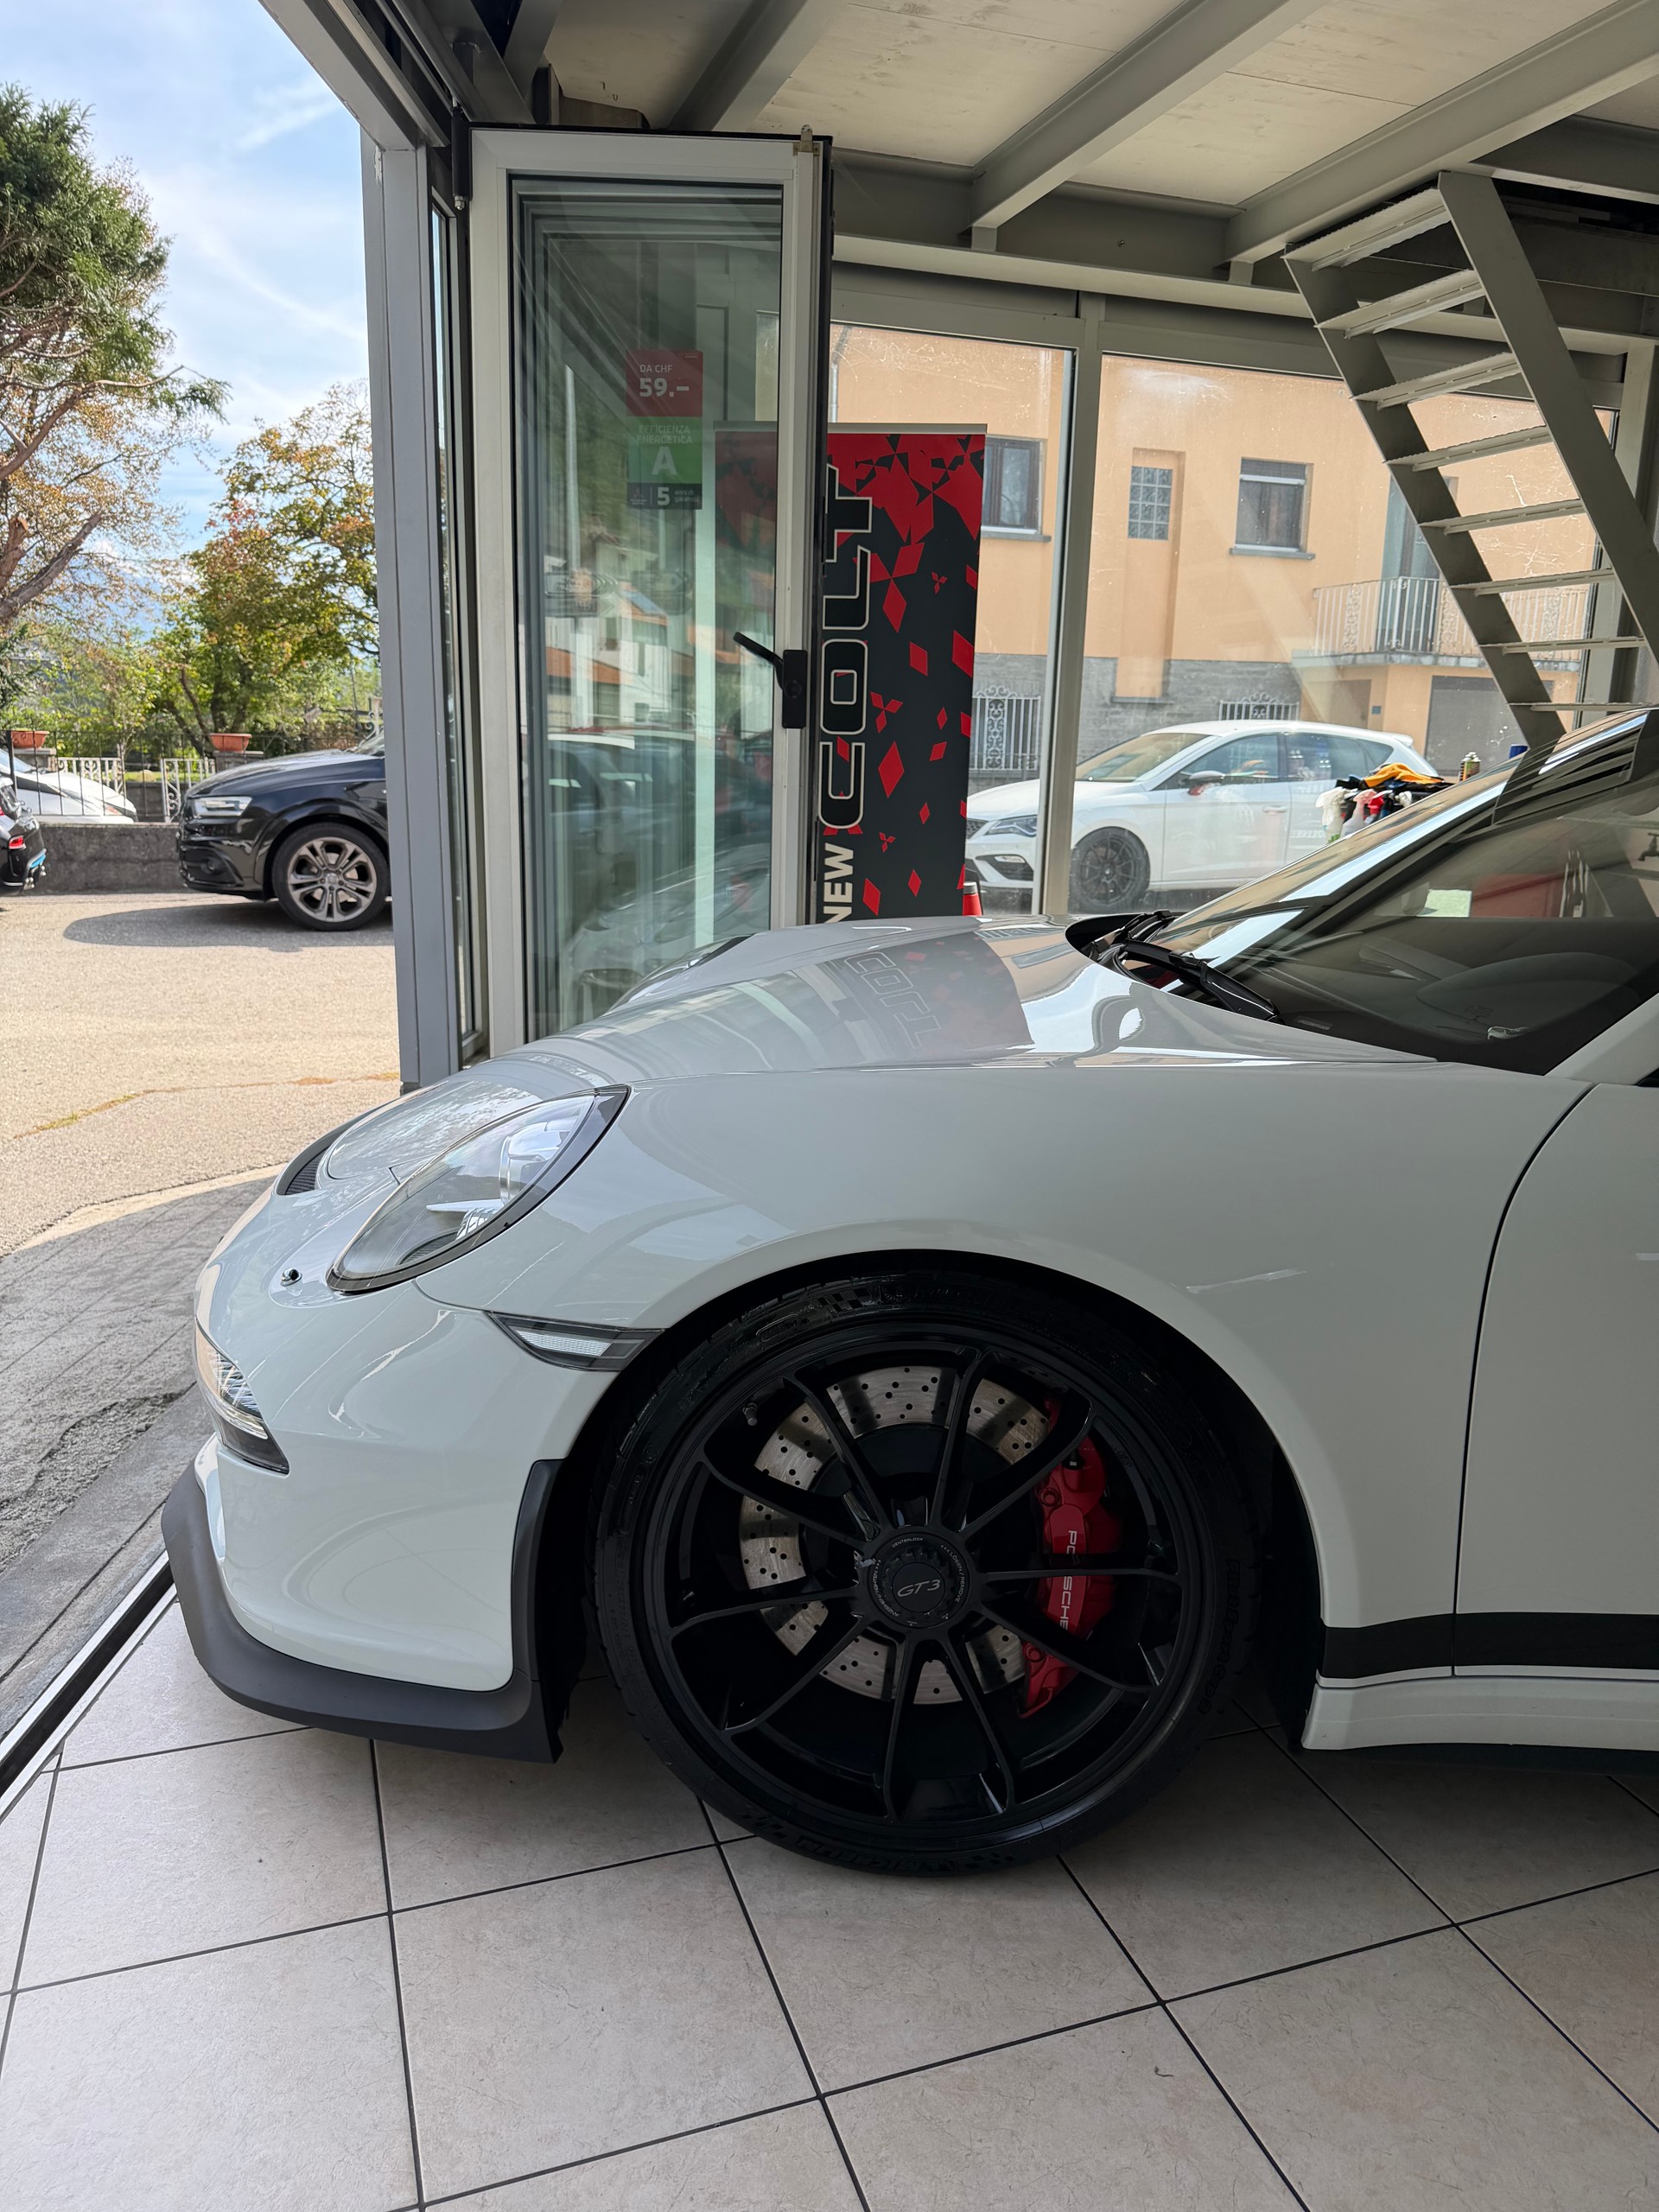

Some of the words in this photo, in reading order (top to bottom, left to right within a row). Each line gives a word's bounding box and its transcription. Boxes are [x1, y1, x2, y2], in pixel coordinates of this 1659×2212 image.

[639, 364, 652, 373] DA
[654, 364, 673, 373] CHF
[639, 424, 690, 434] EFFICIENZA
[636, 435, 692, 444] ENERGETICA
[651, 446, 678, 475] A
[657, 486, 671, 505] 5
[818, 462, 873, 829] COLT
